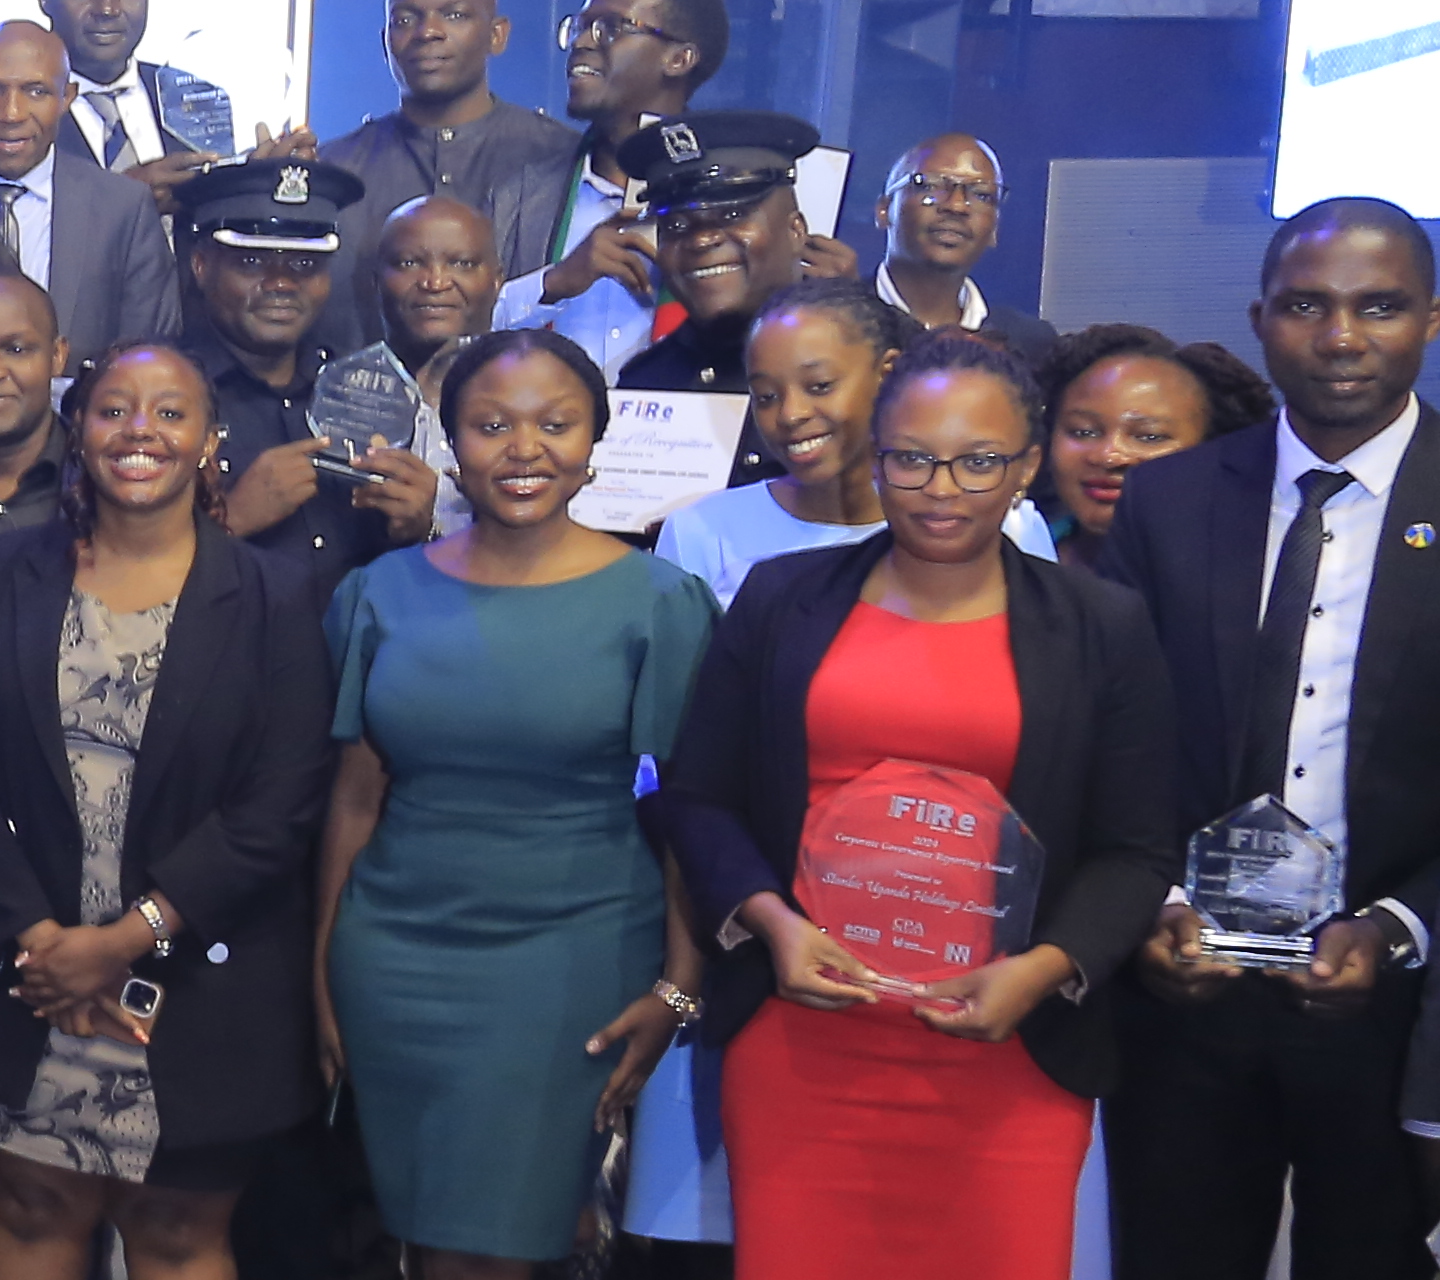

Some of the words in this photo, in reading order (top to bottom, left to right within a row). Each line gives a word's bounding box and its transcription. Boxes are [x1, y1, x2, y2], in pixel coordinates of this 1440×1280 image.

[616, 400, 674, 421] FiRe
[634, 431, 714, 452] Recognition
[888, 795, 977, 832] FiRe
[834, 833, 879, 849] Corporate
[881, 841, 934, 859] Governance
[934, 851, 982, 871] Reporting
[982, 862, 1017, 875] Award
[893, 870, 932, 884] Presented
[822, 872, 863, 891] Stanbic
[866, 879, 910, 900] Uganda
[912, 889, 962, 914] Holdings
[962, 900, 1011, 919] Limited
[891, 918, 925, 934] CPA
